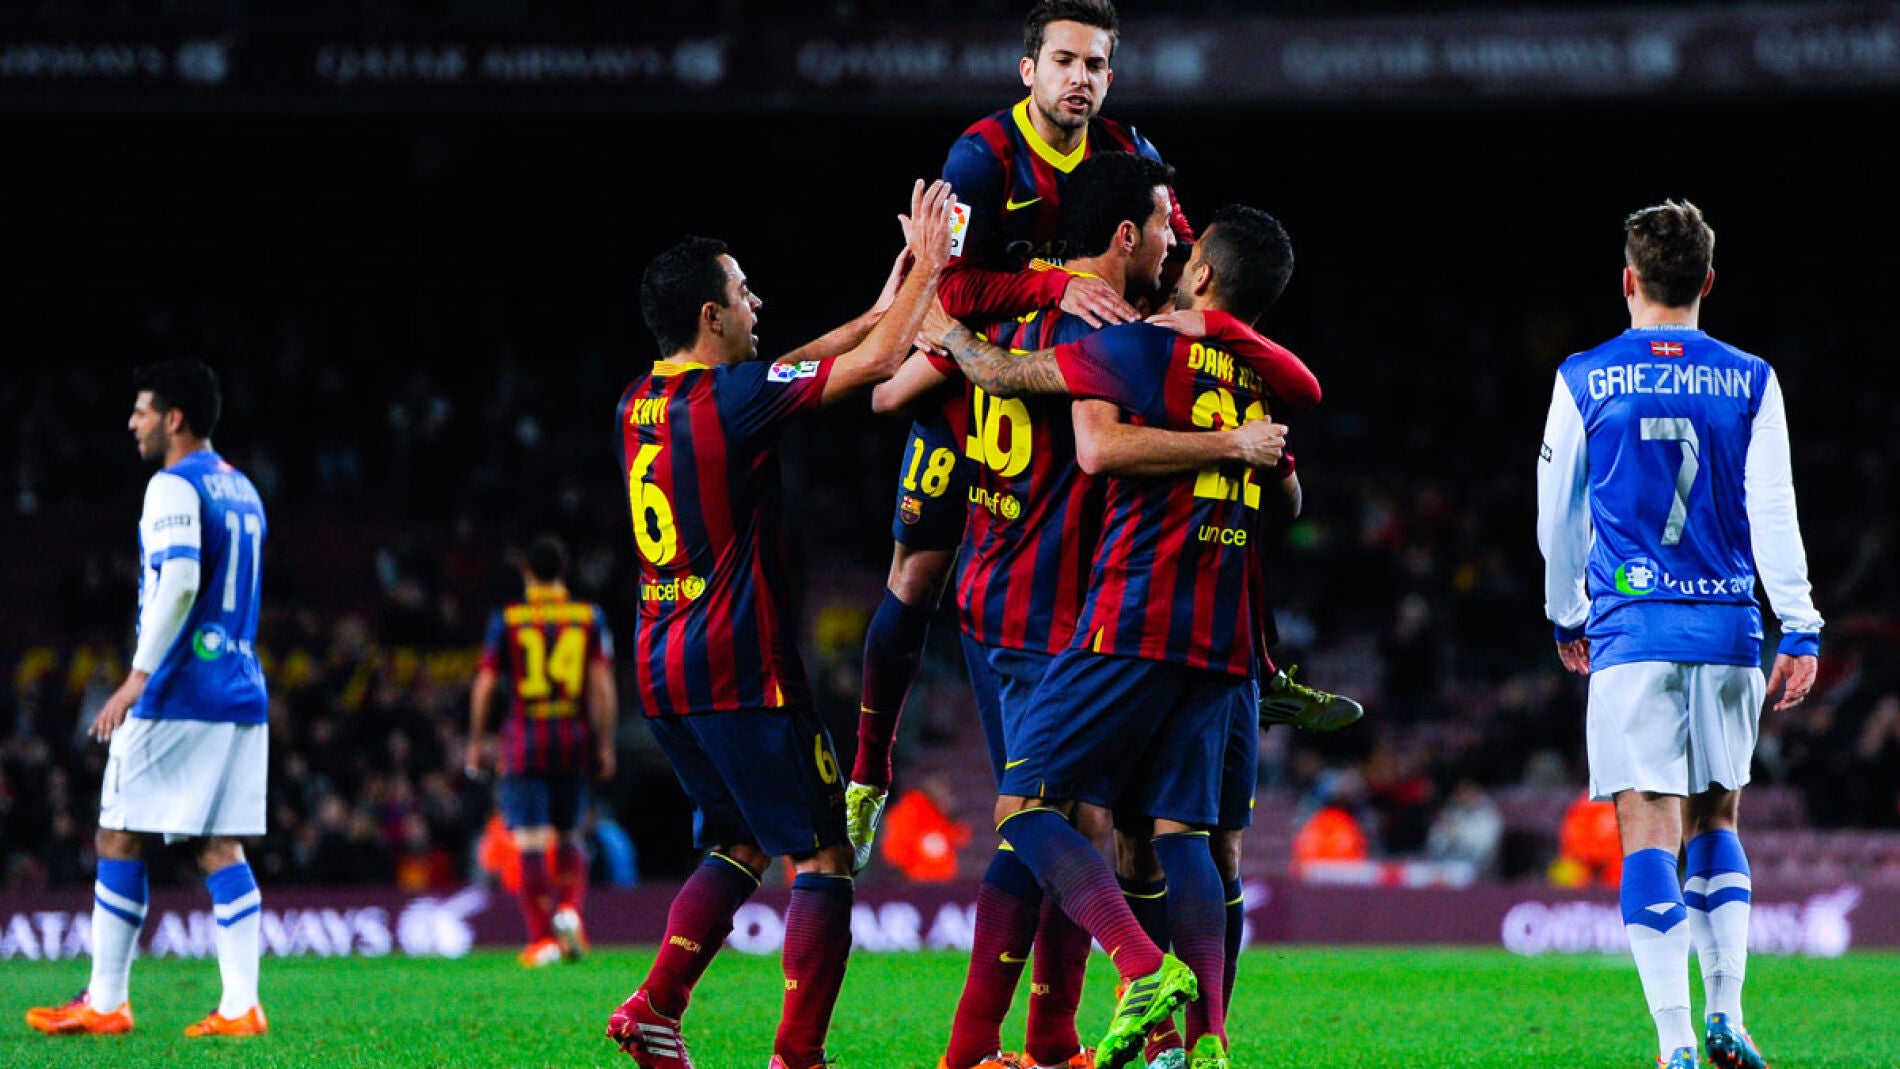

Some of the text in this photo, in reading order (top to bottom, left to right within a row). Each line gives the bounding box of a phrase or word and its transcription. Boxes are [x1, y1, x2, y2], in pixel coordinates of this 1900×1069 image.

[629, 396, 669, 425] XAVI
[1588, 364, 1752, 399] GRIEZMANN
[903, 437, 956, 498] 18
[1640, 417, 1699, 546] 7
[629, 443, 676, 566] 6
[222, 511, 261, 612] 11
[518, 626, 588, 698] 14
[814, 732, 838, 785] 6
